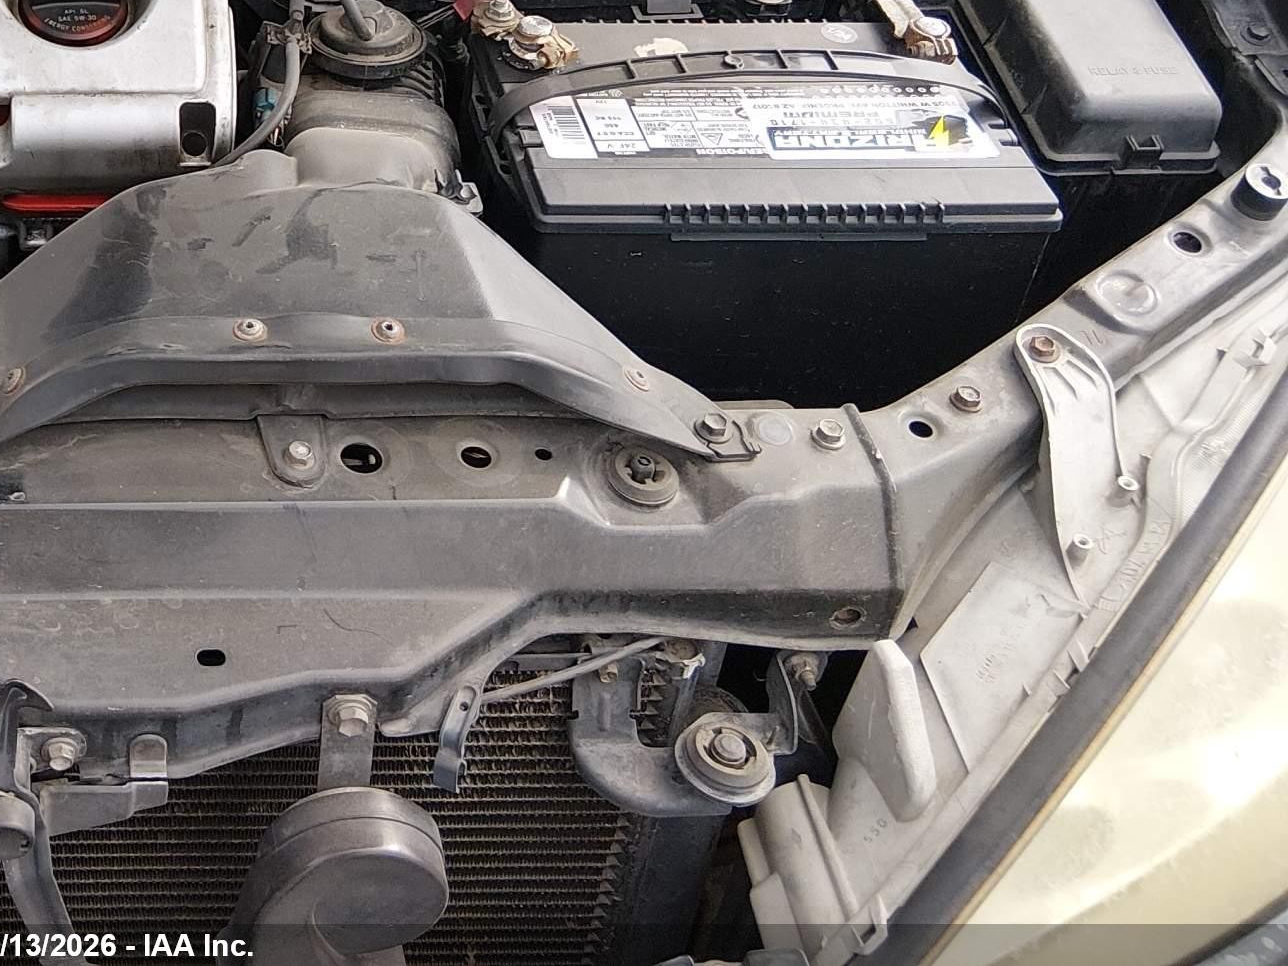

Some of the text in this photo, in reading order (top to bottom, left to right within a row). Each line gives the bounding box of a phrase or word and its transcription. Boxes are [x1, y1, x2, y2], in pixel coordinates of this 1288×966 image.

[1087, 66, 1128, 76] RELAY
[1143, 66, 1177, 75] FUSE
[775, 135, 949, 152] ARIZONA
